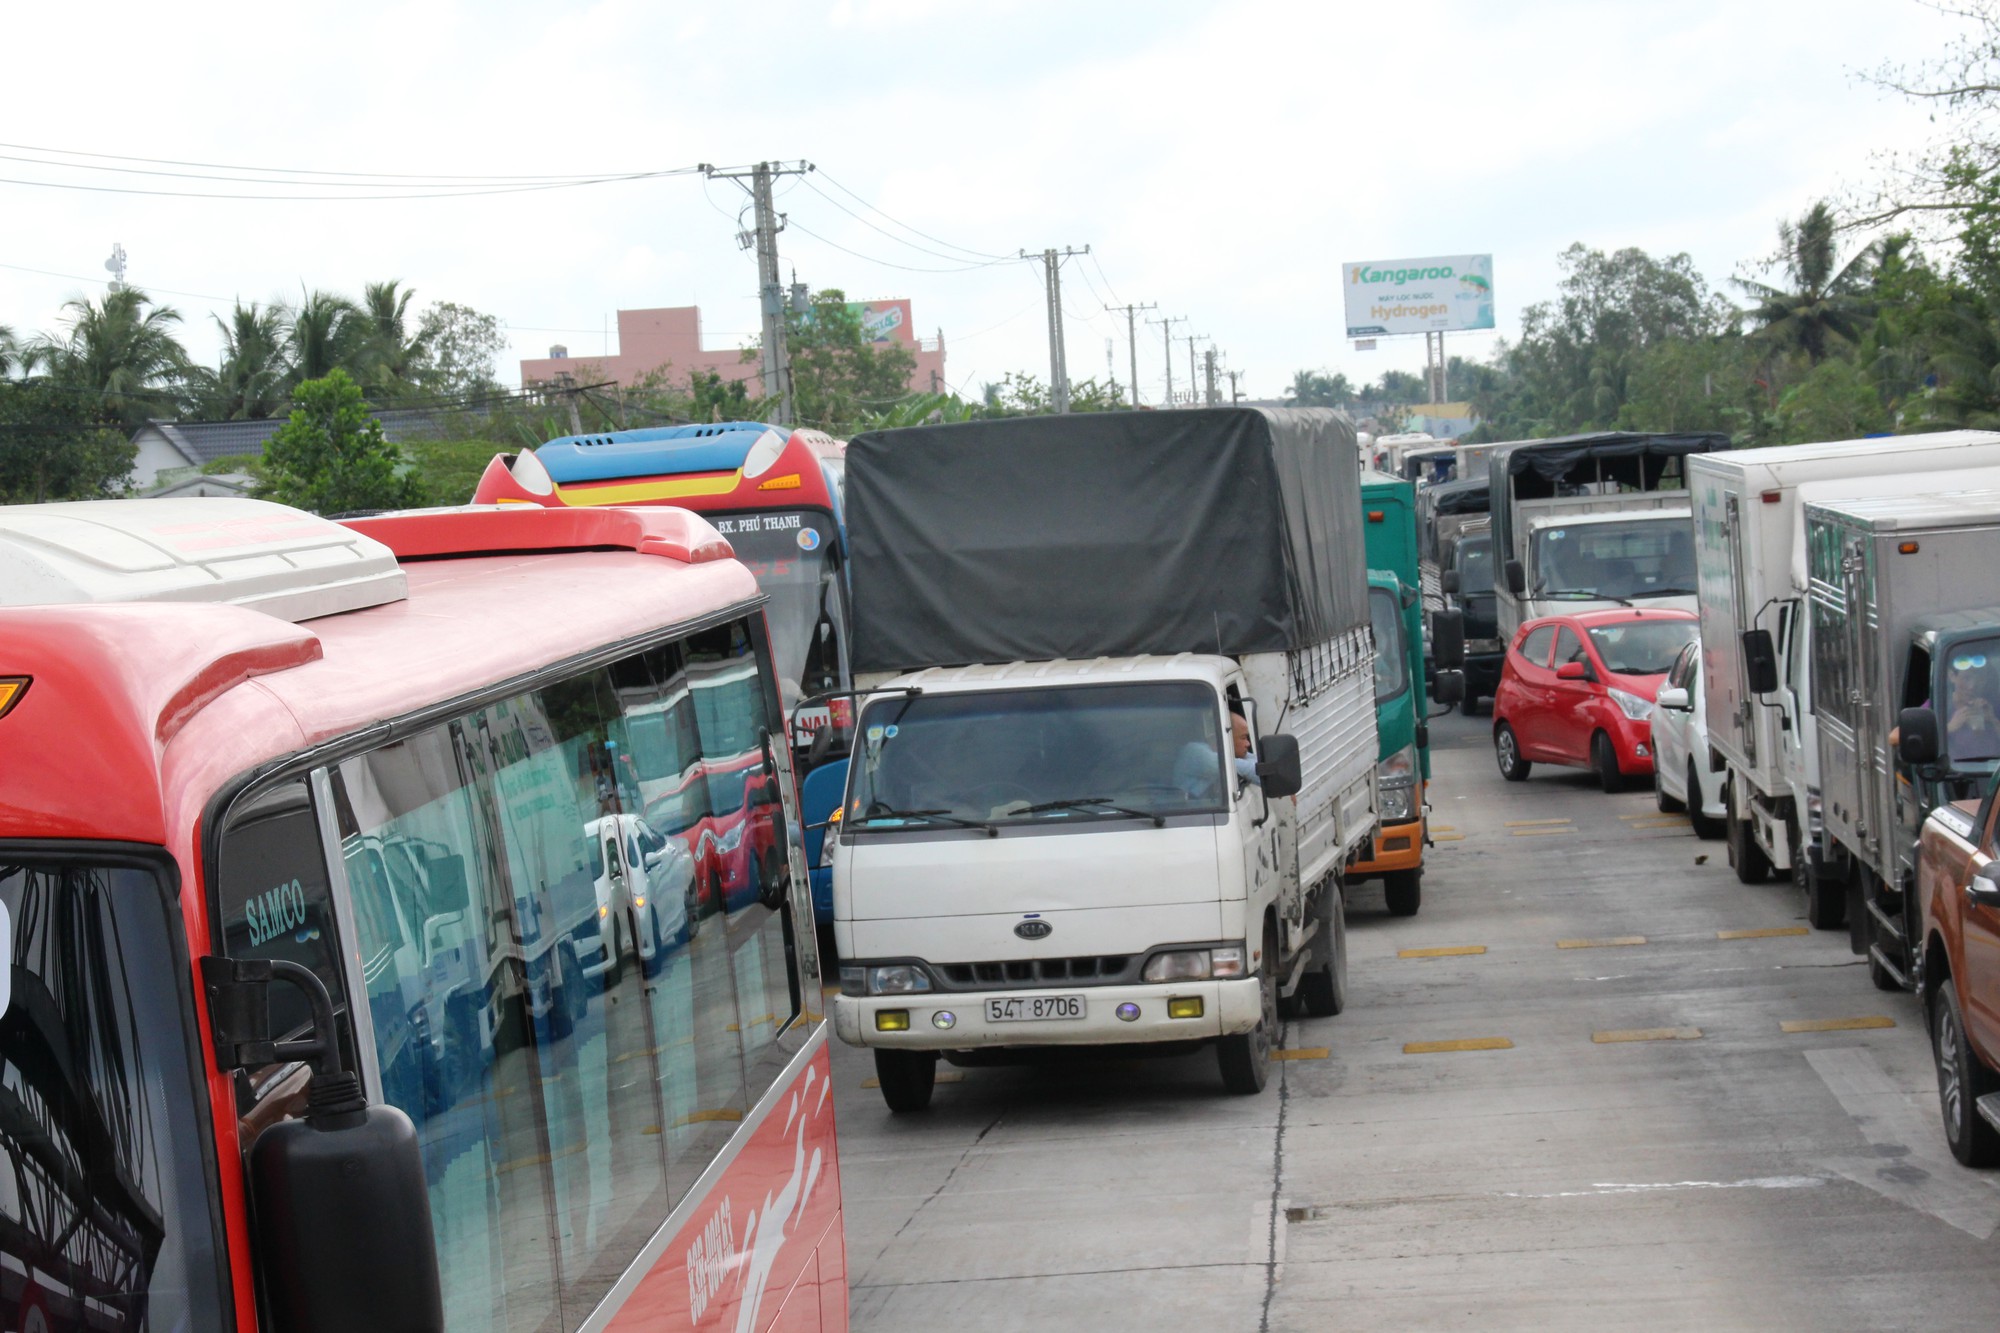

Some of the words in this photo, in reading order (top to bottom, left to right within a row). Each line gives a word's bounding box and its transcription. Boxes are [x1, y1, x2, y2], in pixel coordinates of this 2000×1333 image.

[1371, 304, 1448, 321] Hydrogen
[718, 521, 737, 534] BX.
[739, 515, 760, 532] PHÚ
[763, 515, 801, 531] THẠNH
[245, 878, 306, 948] SAMCO
[1020, 924, 1047, 936] KIA
[1033, 997, 1080, 1017] 8706
